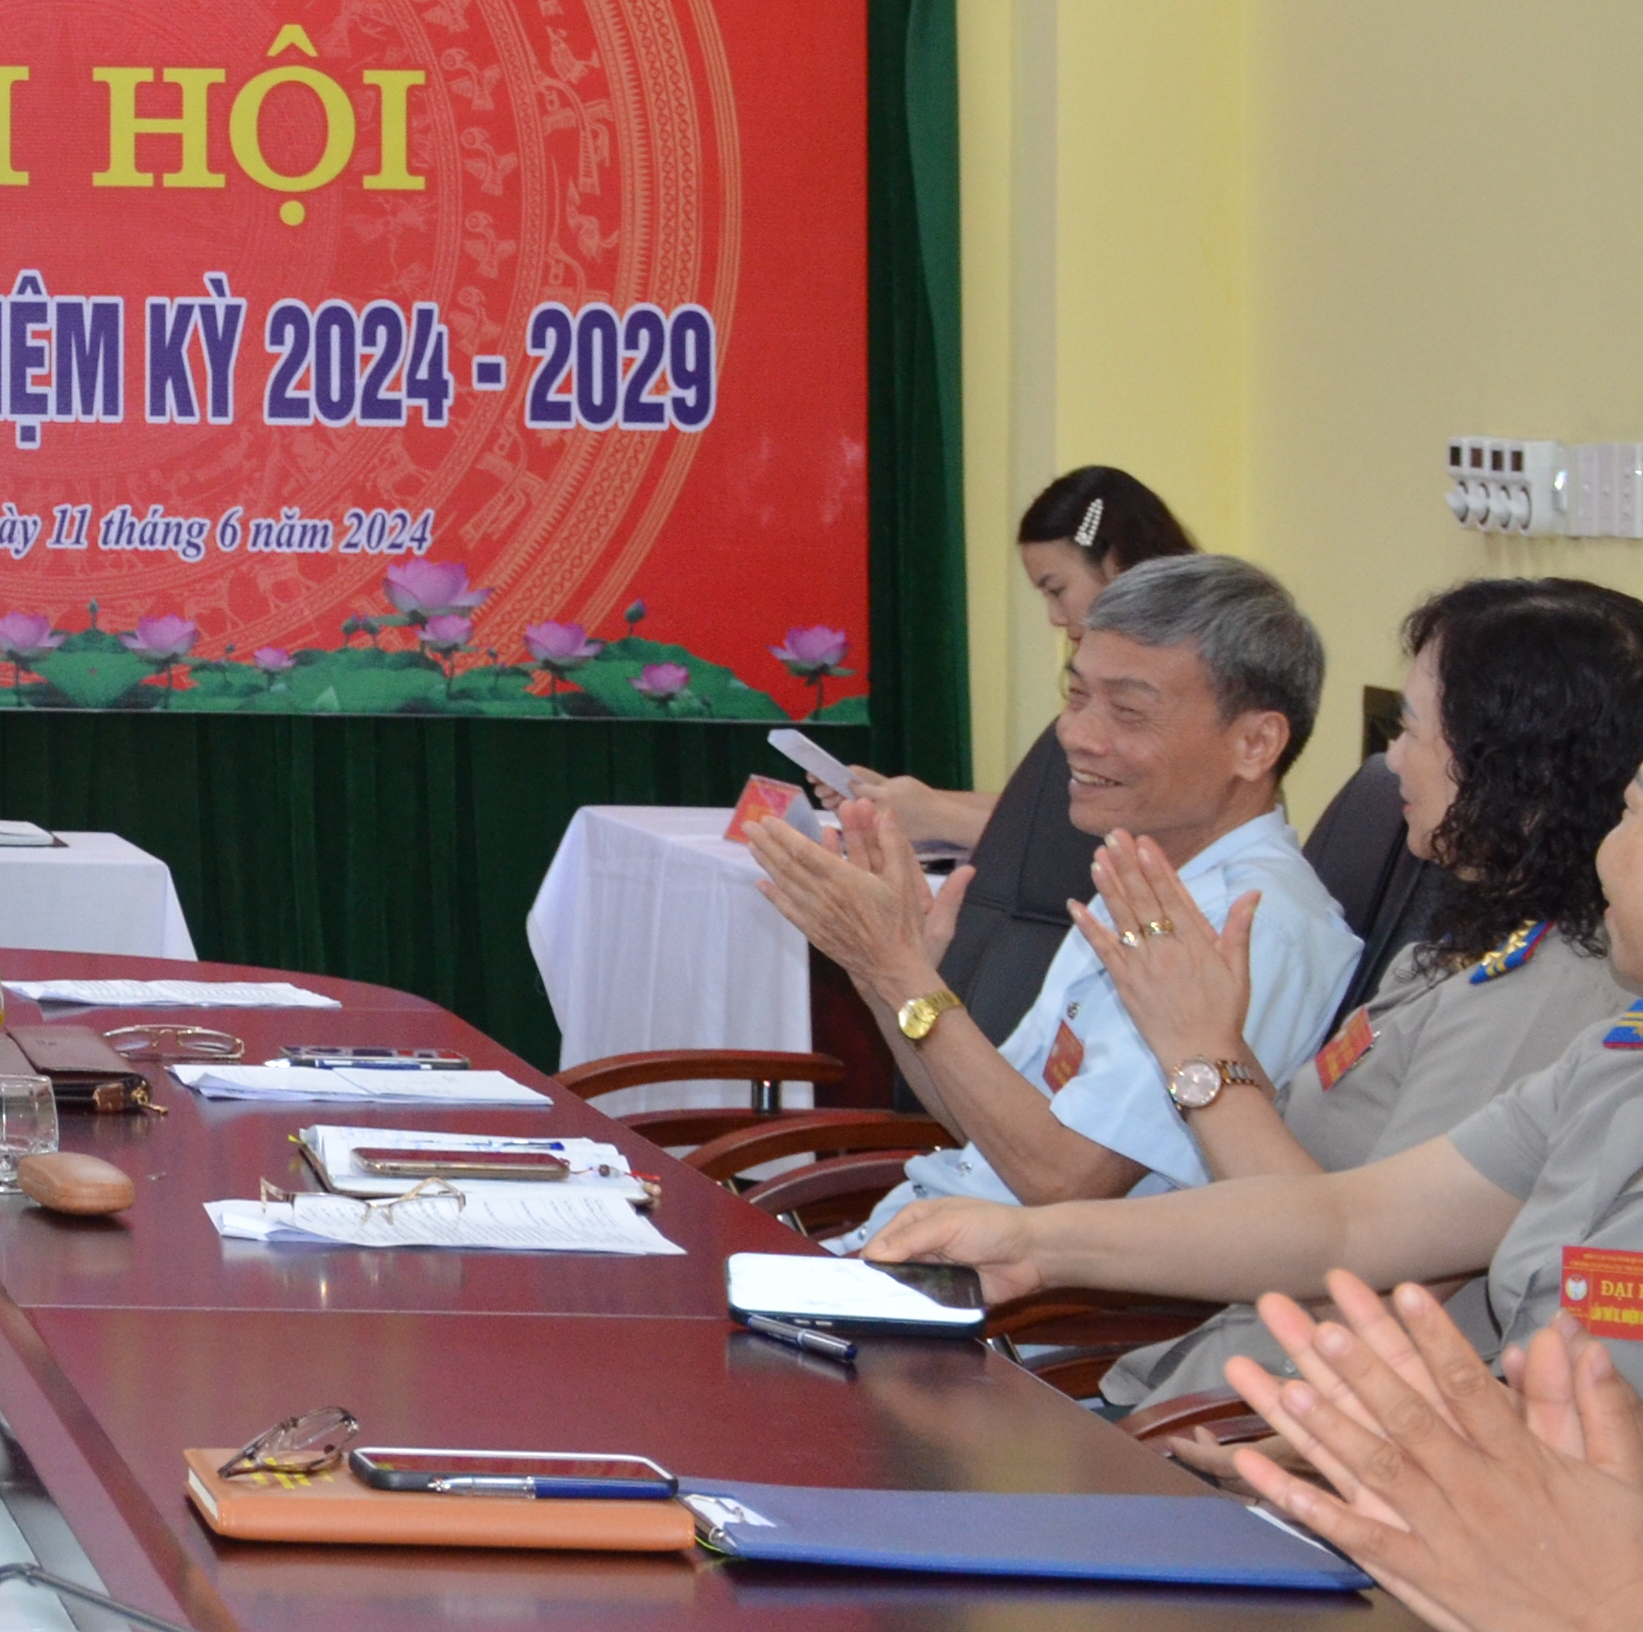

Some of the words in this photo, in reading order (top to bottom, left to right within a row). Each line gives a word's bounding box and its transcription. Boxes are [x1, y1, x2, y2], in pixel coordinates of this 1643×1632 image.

[92, 24, 426, 226] HỘI
[144, 270, 247, 423] KỲ
[264, 297, 450, 427] 2024
[524, 301, 716, 432] 2029
[46, 503, 92, 549] 11
[99, 504, 210, 562] tháng
[216, 505, 244, 551] 6
[248, 506, 333, 553] năm
[339, 508, 435, 556] 2024
[1600, 1279, 1634, 1302] ĐẠI
